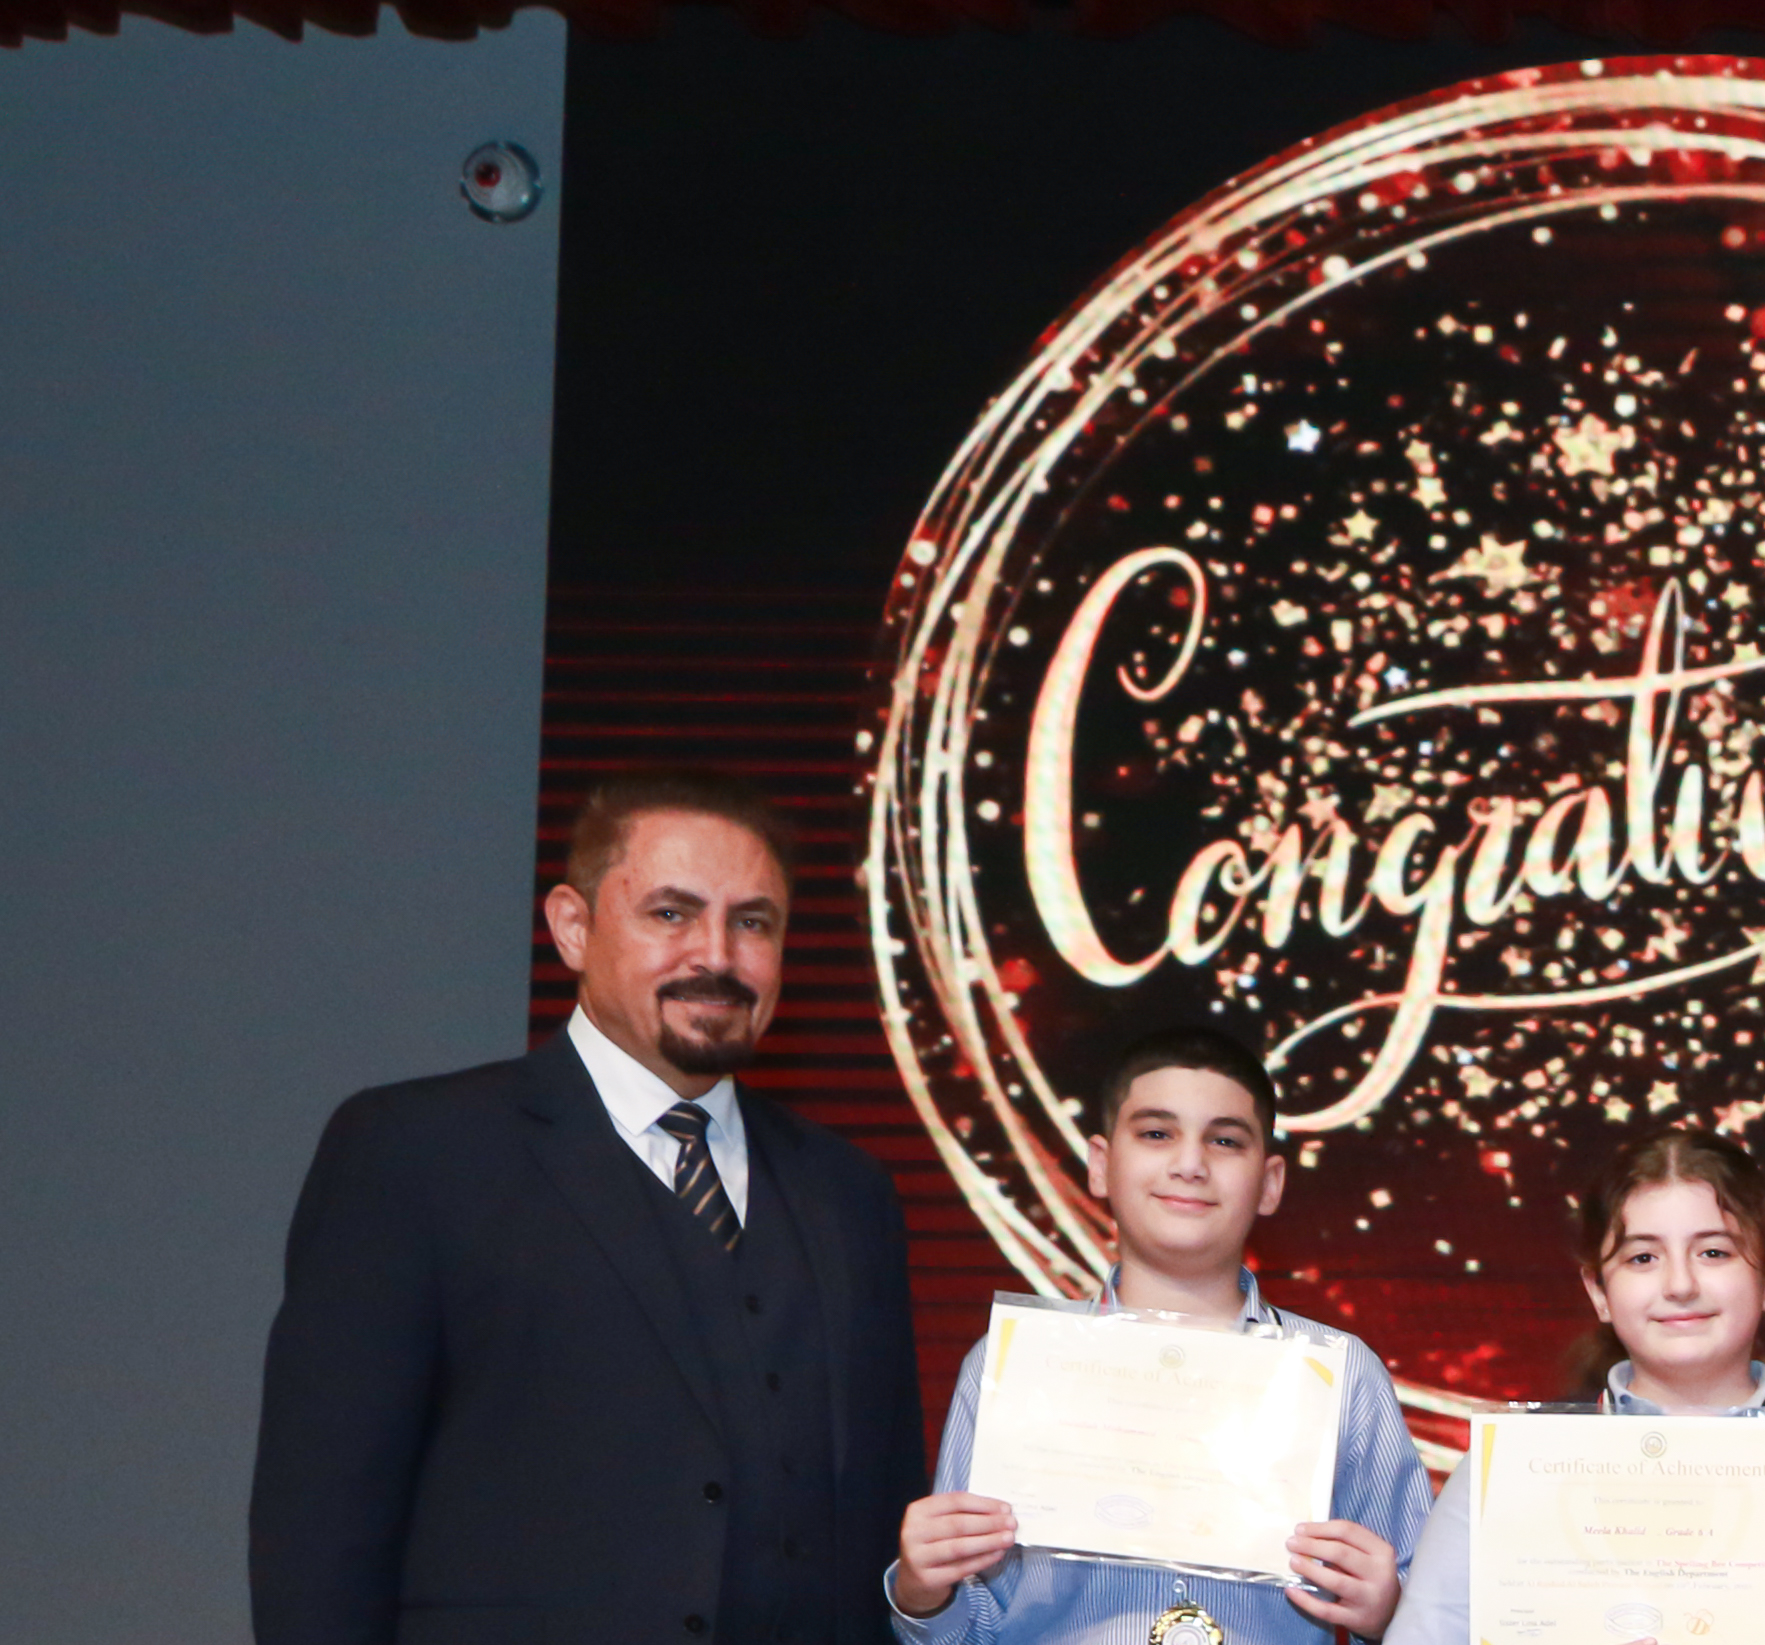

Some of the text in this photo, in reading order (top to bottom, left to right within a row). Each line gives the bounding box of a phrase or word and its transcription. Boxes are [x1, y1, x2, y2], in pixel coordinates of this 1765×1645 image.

[1528, 1456, 1620, 1475] Certificate
[1626, 1458, 1646, 1475] of
[1665, 1527, 1693, 1535] Grade
[1643, 1568, 1674, 1577] English
[1677, 1568, 1728, 1578] Department
